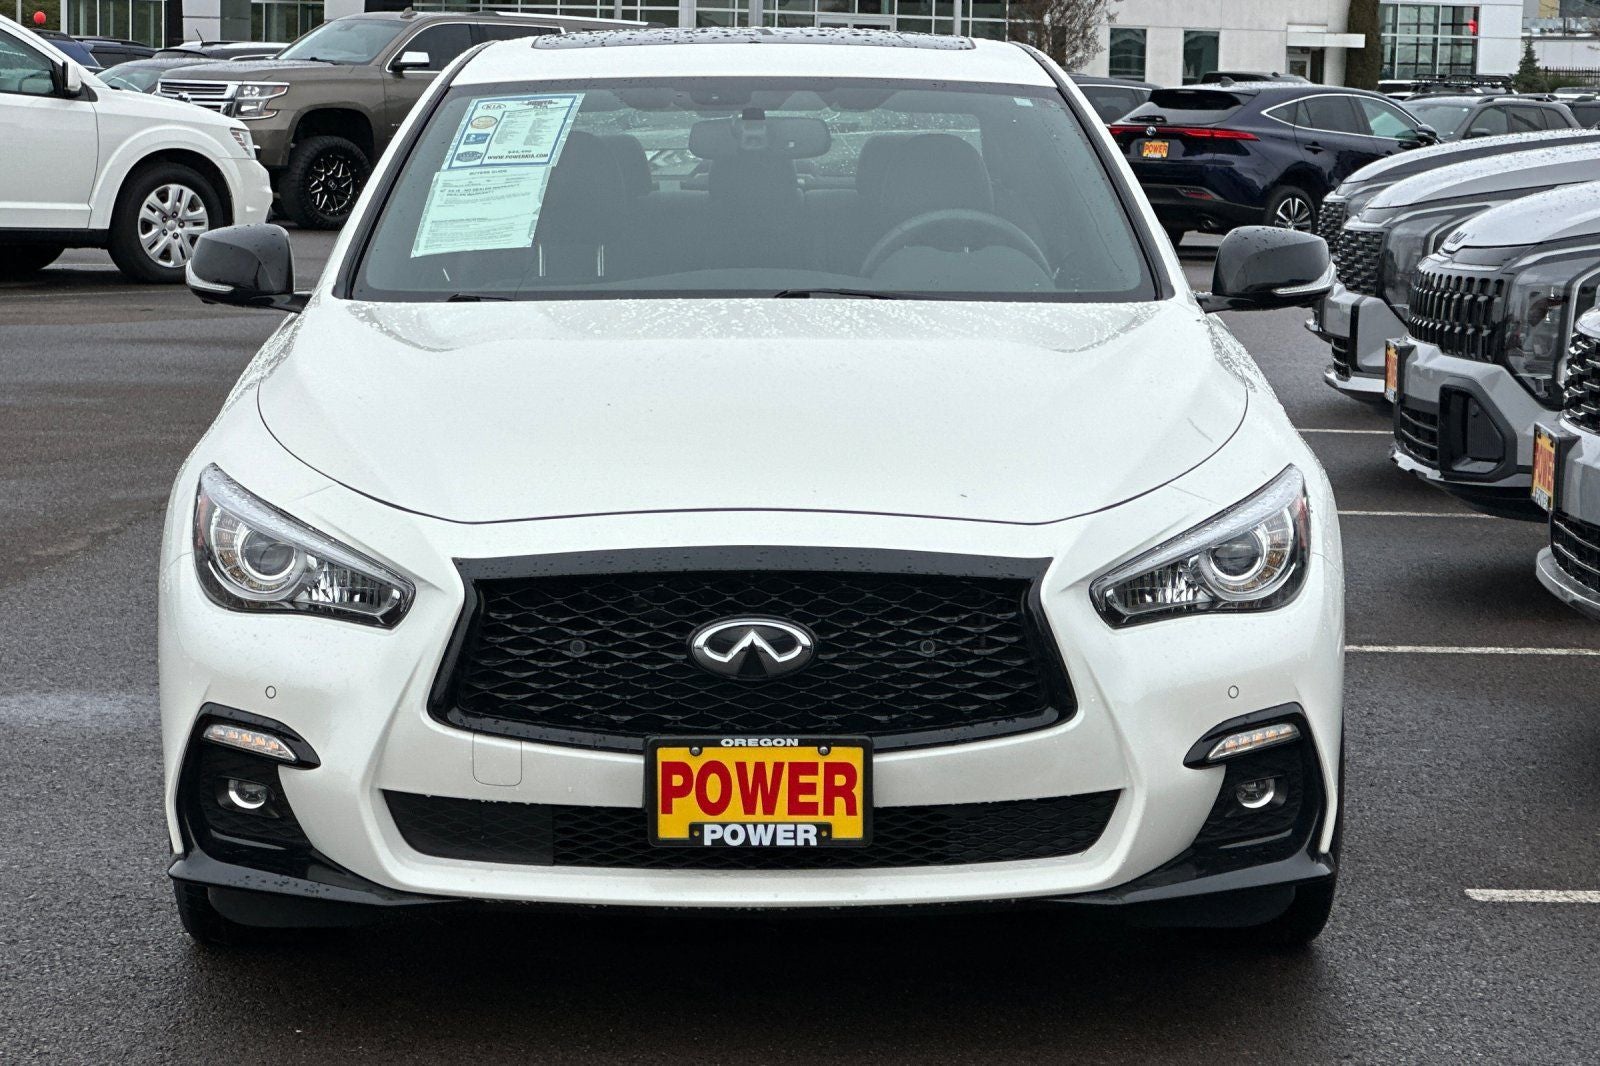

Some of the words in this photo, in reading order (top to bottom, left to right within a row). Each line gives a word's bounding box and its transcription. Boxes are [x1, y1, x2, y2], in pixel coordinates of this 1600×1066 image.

[1144, 143, 1167, 153] POWER
[720, 738, 799, 748] OREGON
[660, 760, 858, 817] POWER
[704, 823, 818, 847] POWER
